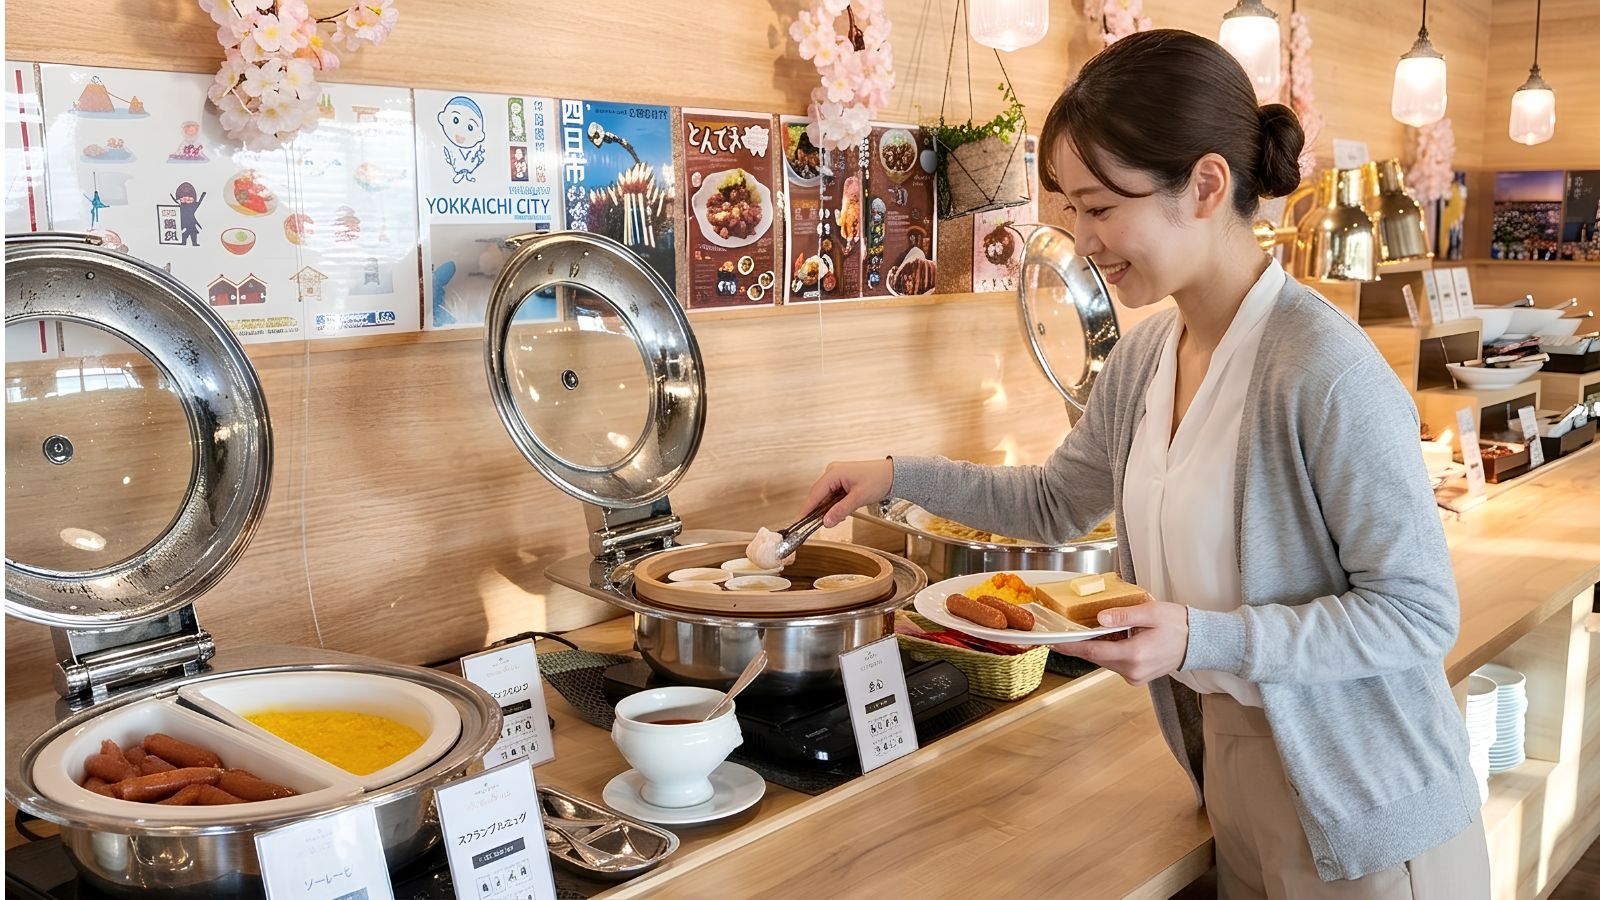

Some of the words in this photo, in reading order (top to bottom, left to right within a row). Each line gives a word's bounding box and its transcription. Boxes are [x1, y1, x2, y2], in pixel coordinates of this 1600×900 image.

[562, 100, 587, 184] 四日市
[426, 197, 512, 216] YOKKAICHI
[516, 198, 550, 216] CITY
